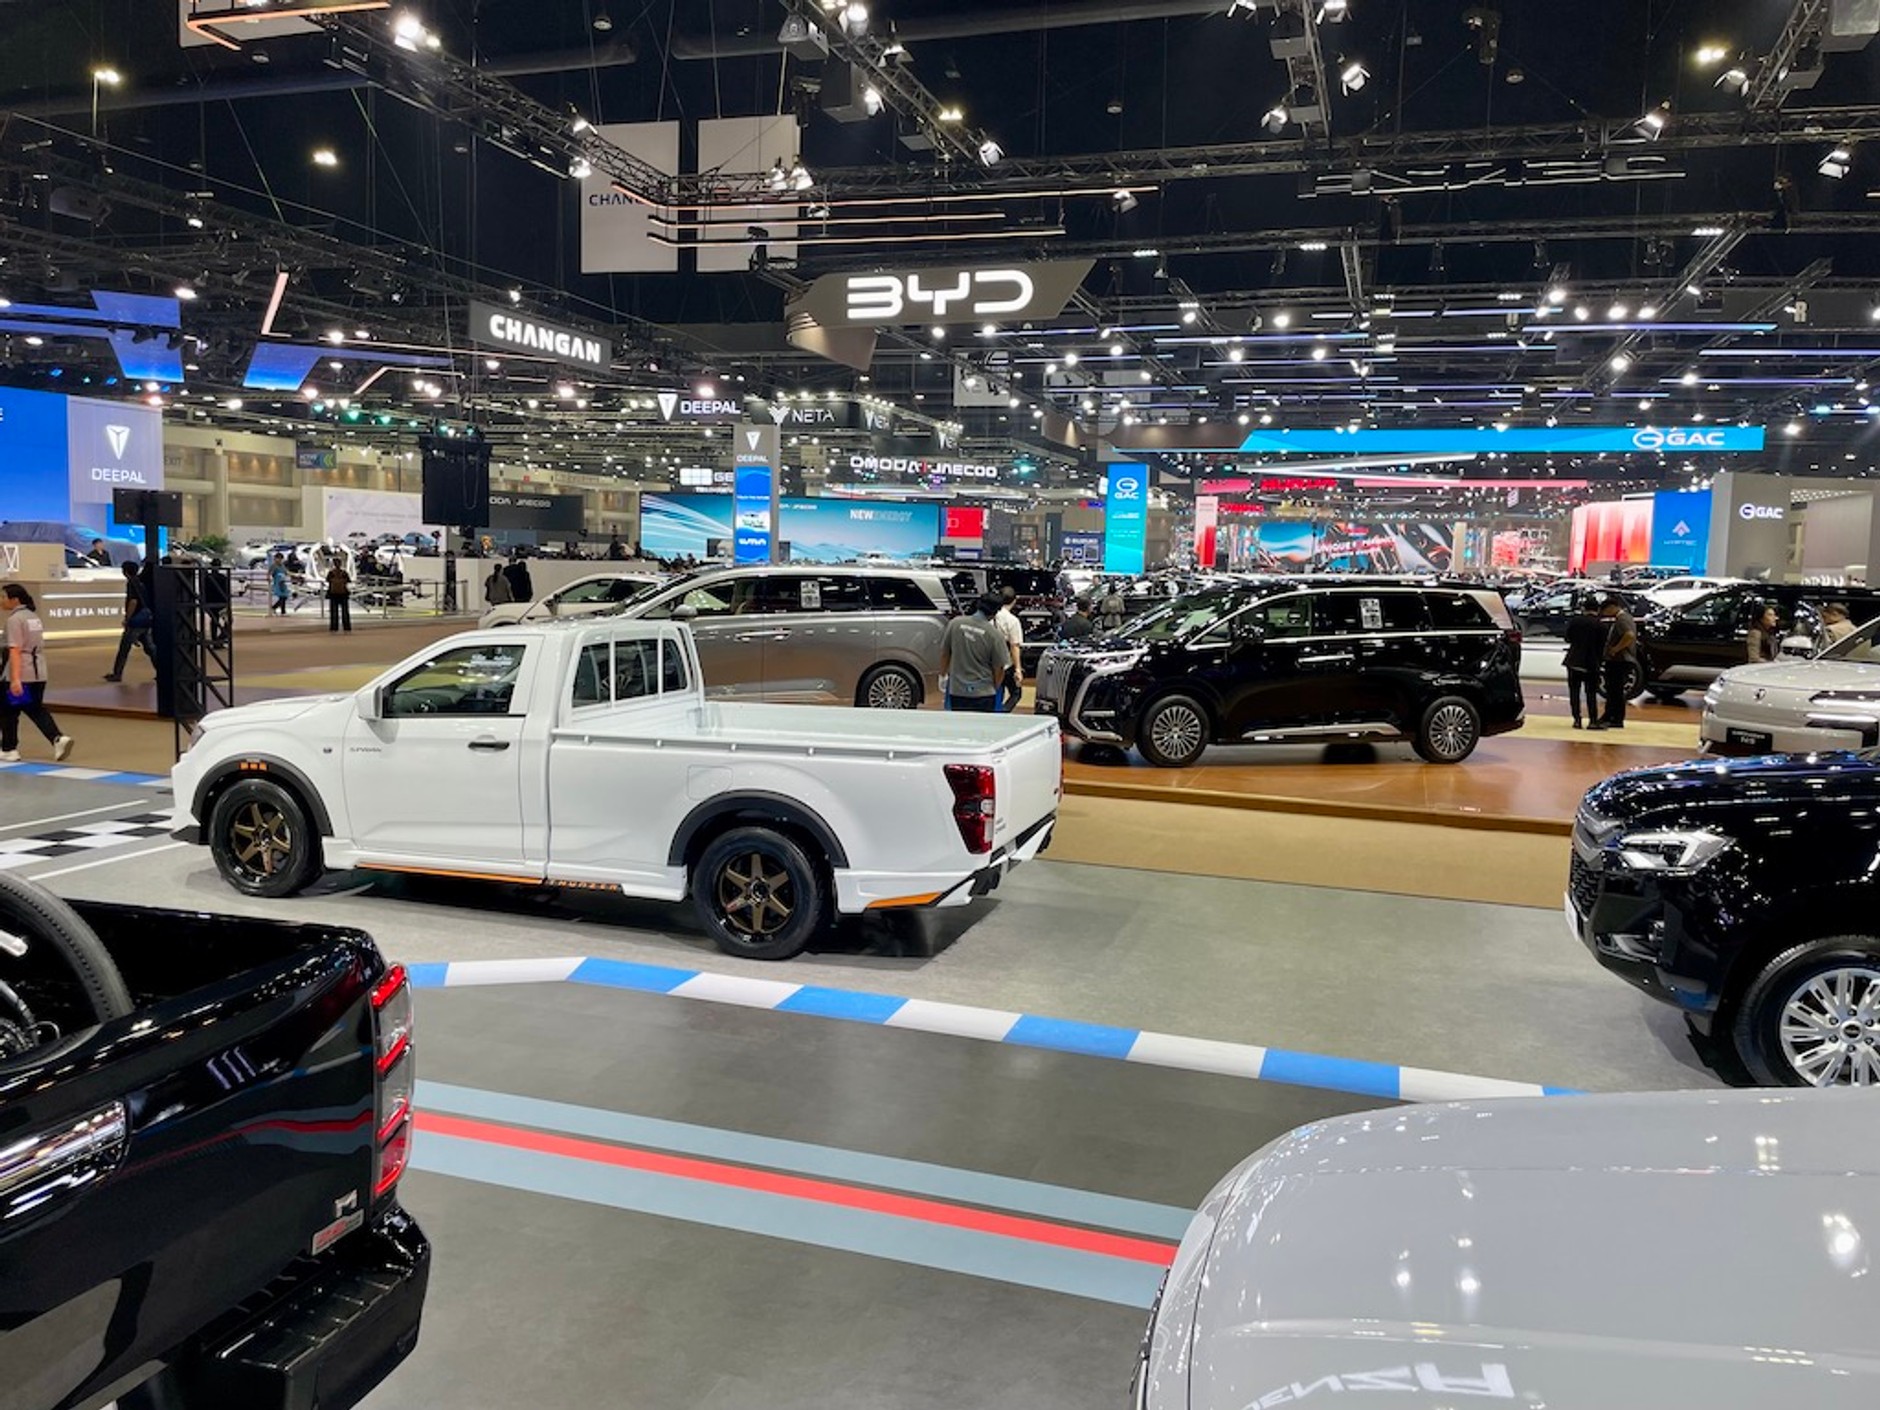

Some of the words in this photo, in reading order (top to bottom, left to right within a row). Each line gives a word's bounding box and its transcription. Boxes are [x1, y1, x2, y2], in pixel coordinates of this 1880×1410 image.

[847, 269, 1034, 319] BYD
[489, 313, 601, 364] CHANGAN
[680, 400, 741, 415] DEEPAL
[792, 408, 835, 424] NETA
[1666, 432, 1726, 446] GAC
[736, 455, 768, 463] DEEPAL
[850, 456, 920, 473] OMODA
[930, 463, 998, 478] JAECOO
[91, 468, 146, 484] DEEPAL
[714, 472, 734, 482] GE
[1114, 491, 1140, 500] GAC
[850, 509, 873, 521] NEW
[1756, 507, 1784, 519] GAC
[49, 608, 72, 618] NEW
[75, 607, 94, 617] ERA
[97, 606, 119, 616] NEW
